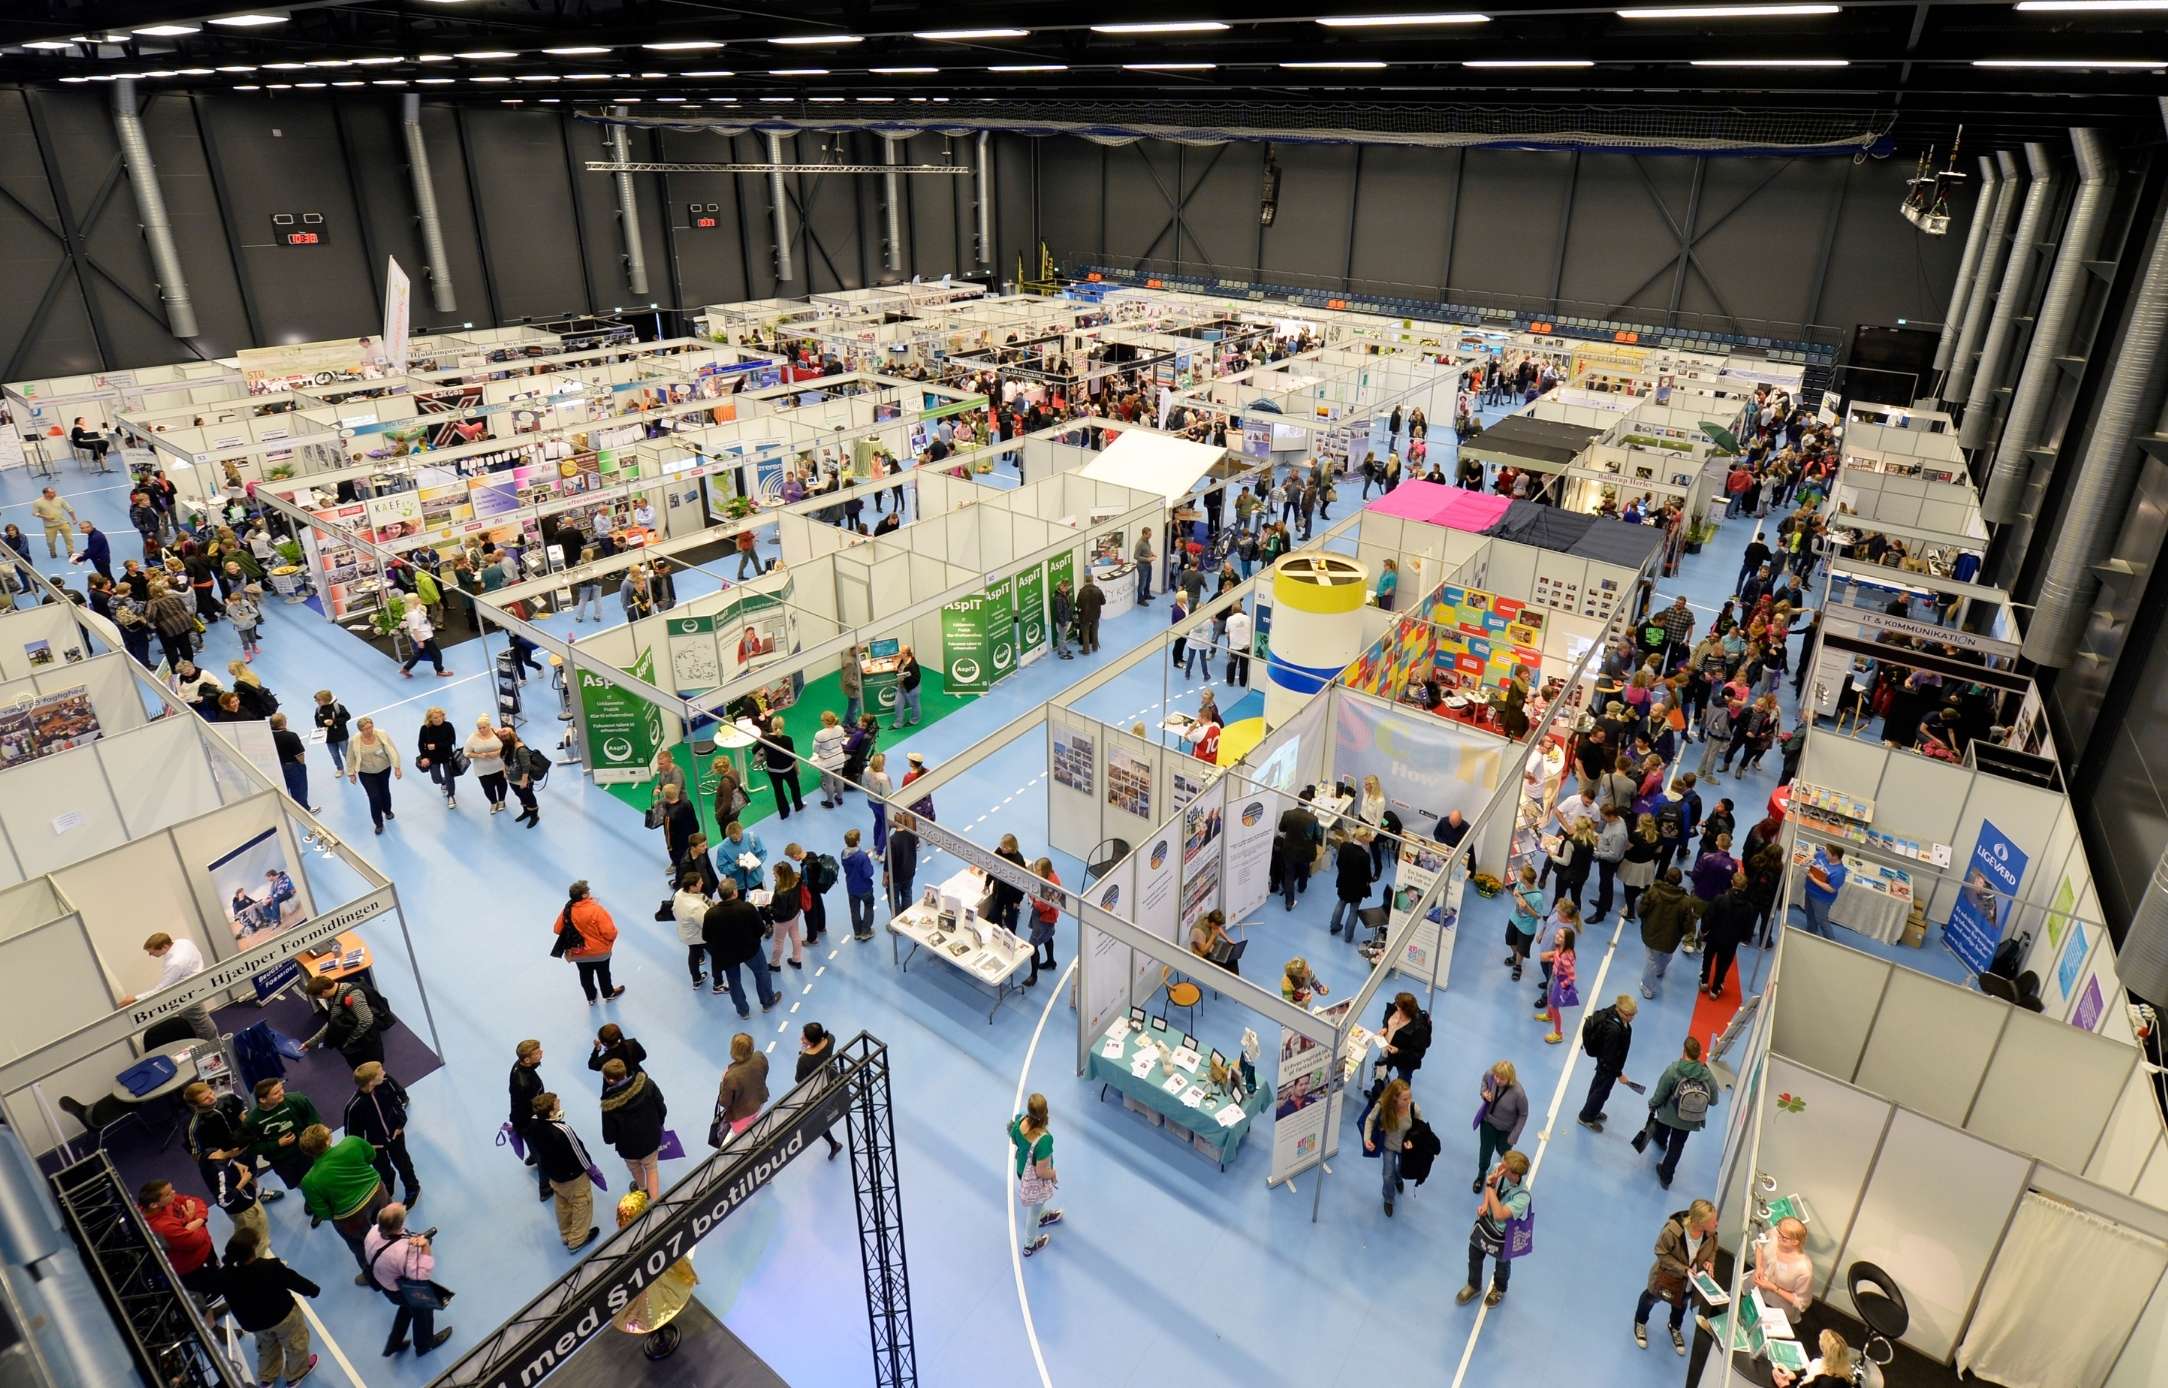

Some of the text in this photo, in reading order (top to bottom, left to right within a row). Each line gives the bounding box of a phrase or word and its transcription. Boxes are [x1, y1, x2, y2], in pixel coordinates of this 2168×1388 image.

[1050, 553, 1073, 573] AspIT
[1018, 567, 1041, 588] AspIT
[986, 581, 1011, 601] AspIT
[944, 599, 983, 613] AspIT
[1885, 620, 1976, 646] KOMMUNIKATION
[583, 674, 615, 689] Asp
[917, 821, 975, 862] Skolerne
[984, 856, 1041, 897] Boserup
[1977, 844, 2016, 885] LIGEVÆRD
[210, 951, 276, 989] Hjælper
[281, 900, 380, 954] Formidlingen
[520, 1307, 600, 1388] med
[691, 1129, 803, 1240] botilbud
